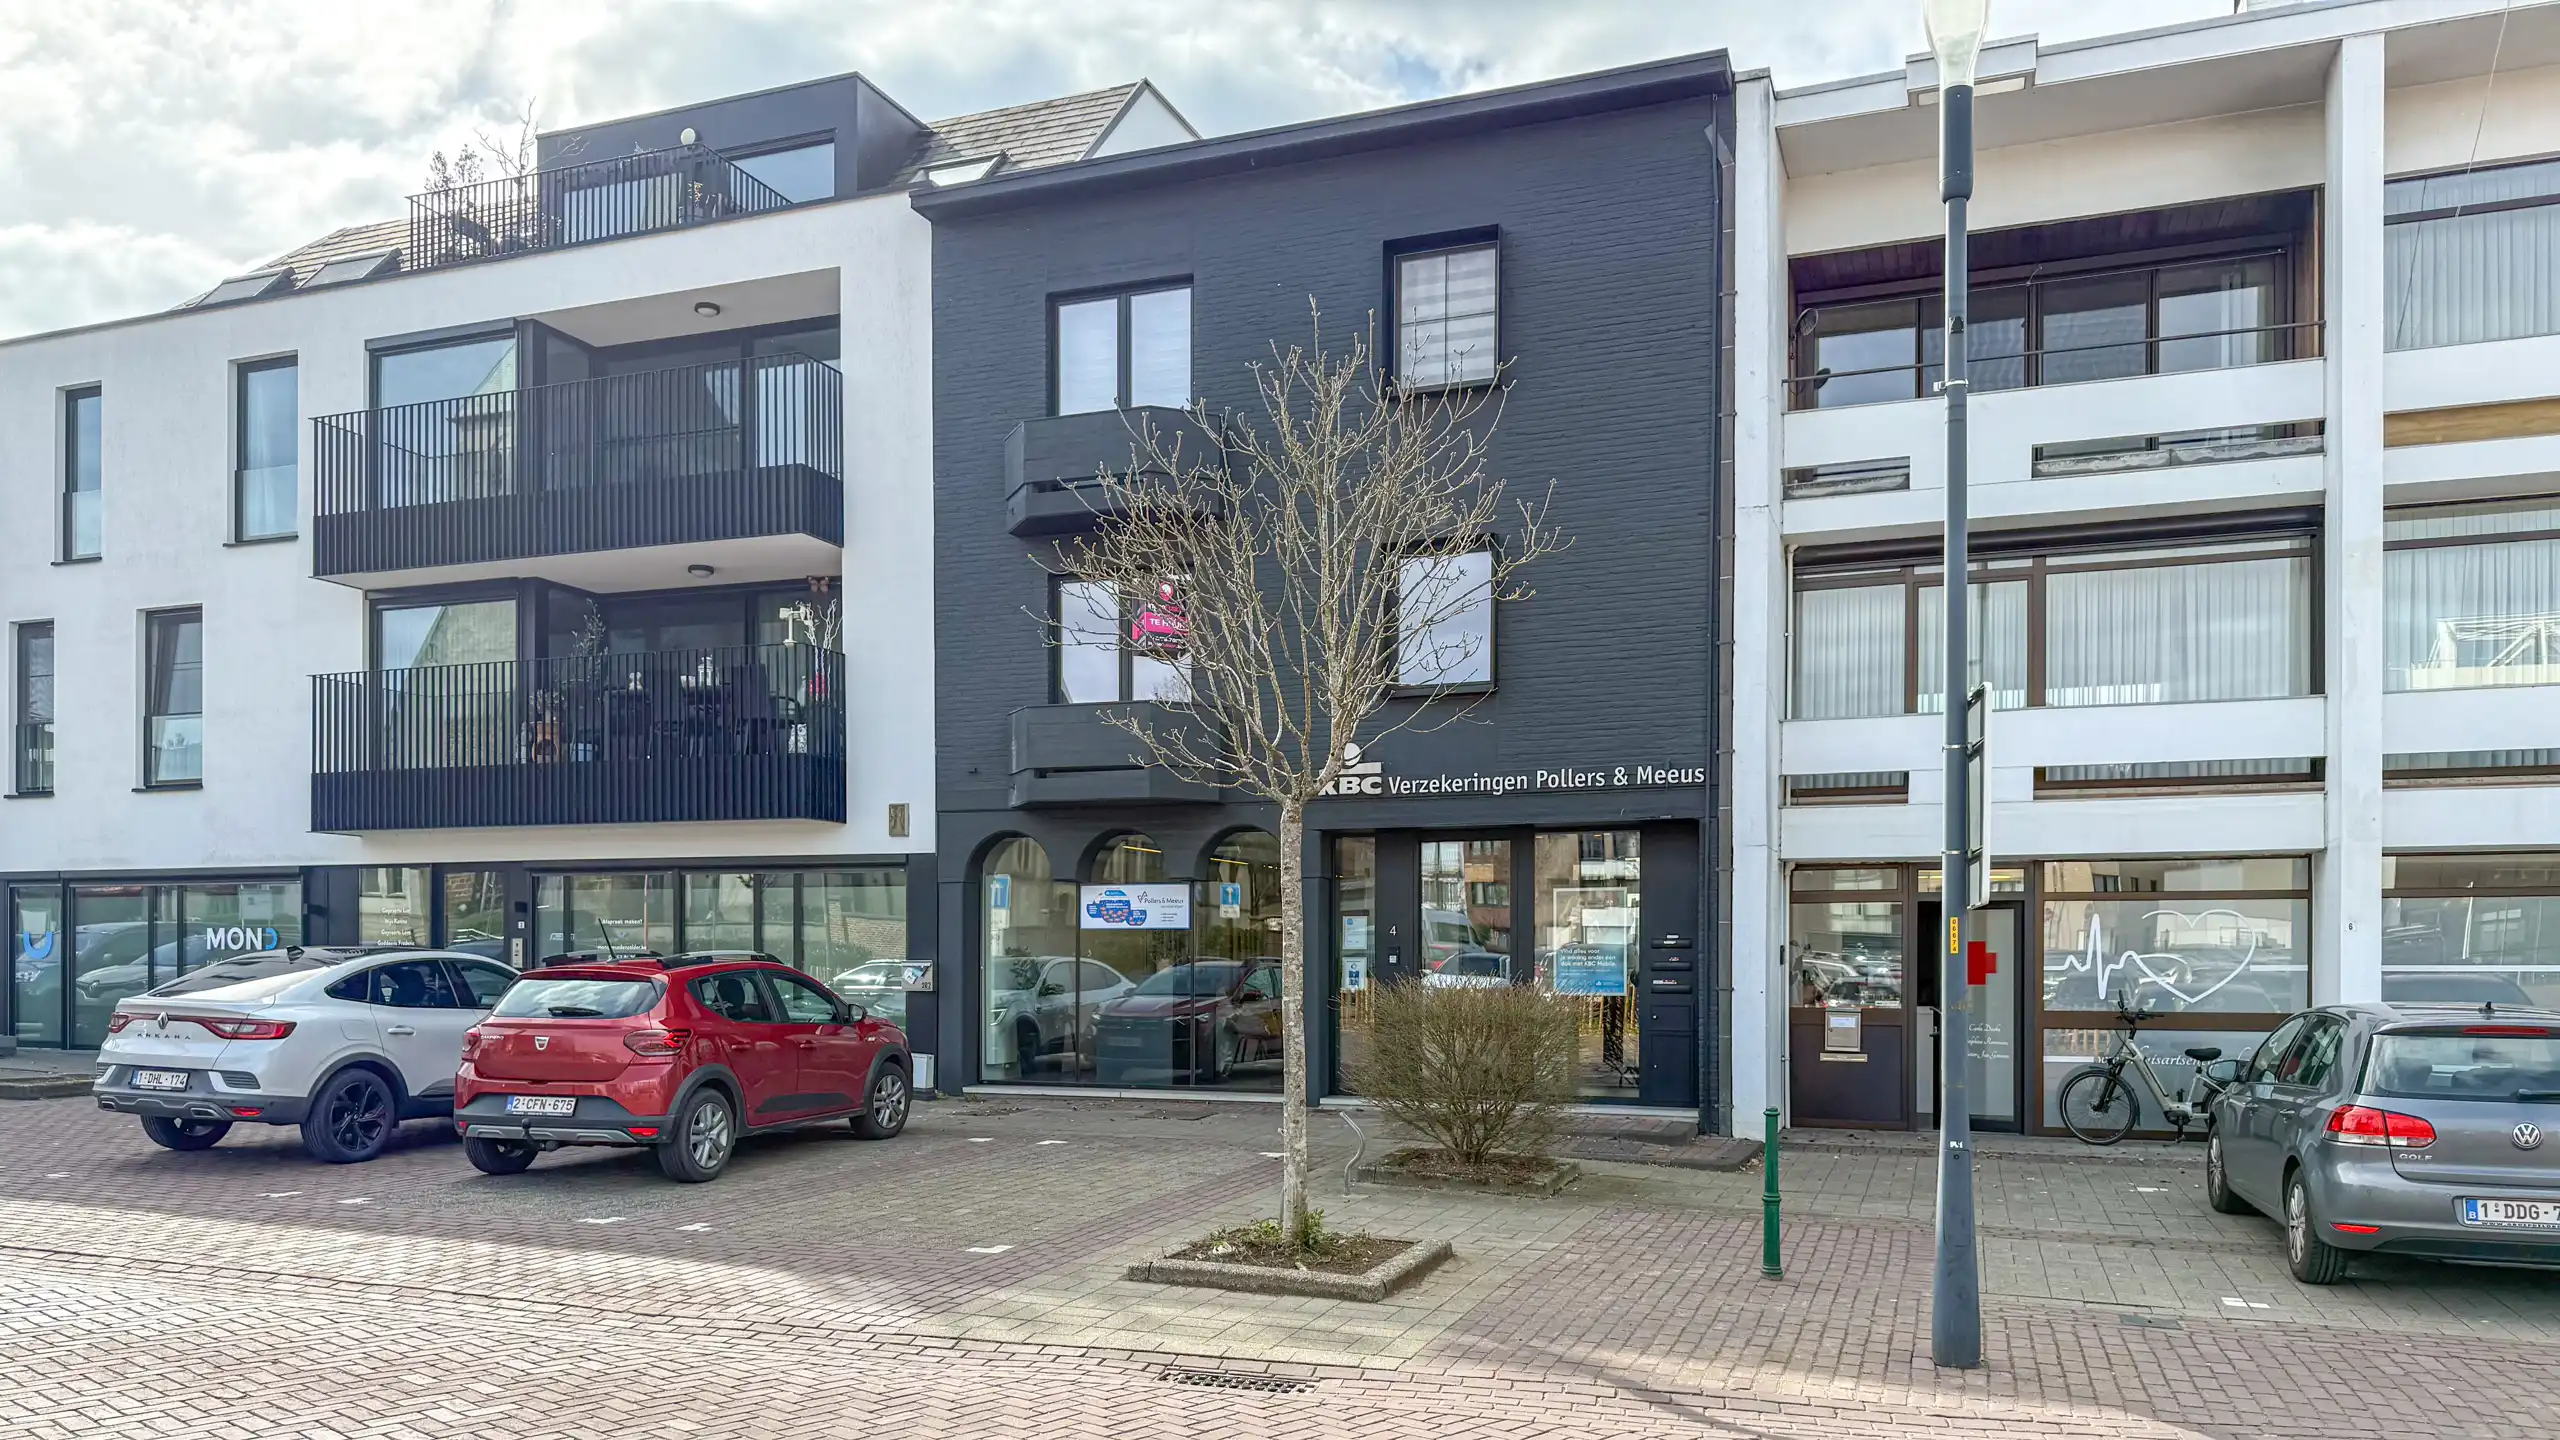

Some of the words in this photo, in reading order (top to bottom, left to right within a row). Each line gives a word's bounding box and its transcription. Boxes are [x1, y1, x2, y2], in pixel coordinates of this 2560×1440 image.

[1149, 618, 1161, 626] TE
[1389, 772, 1528, 796] Verzekeringen
[1536, 768, 1605, 789] Pollers
[1613, 766, 1628, 786] &
[1636, 765, 1705, 785] Meeus
[1389, 925, 1397, 936] 4
[2348, 922, 2353, 931] 6
[138, 1072, 186, 1086] 1-DHL-174
[513, 1097, 573, 1111] 2-CFN-675
[2399, 1153, 2433, 1161] GOLF
